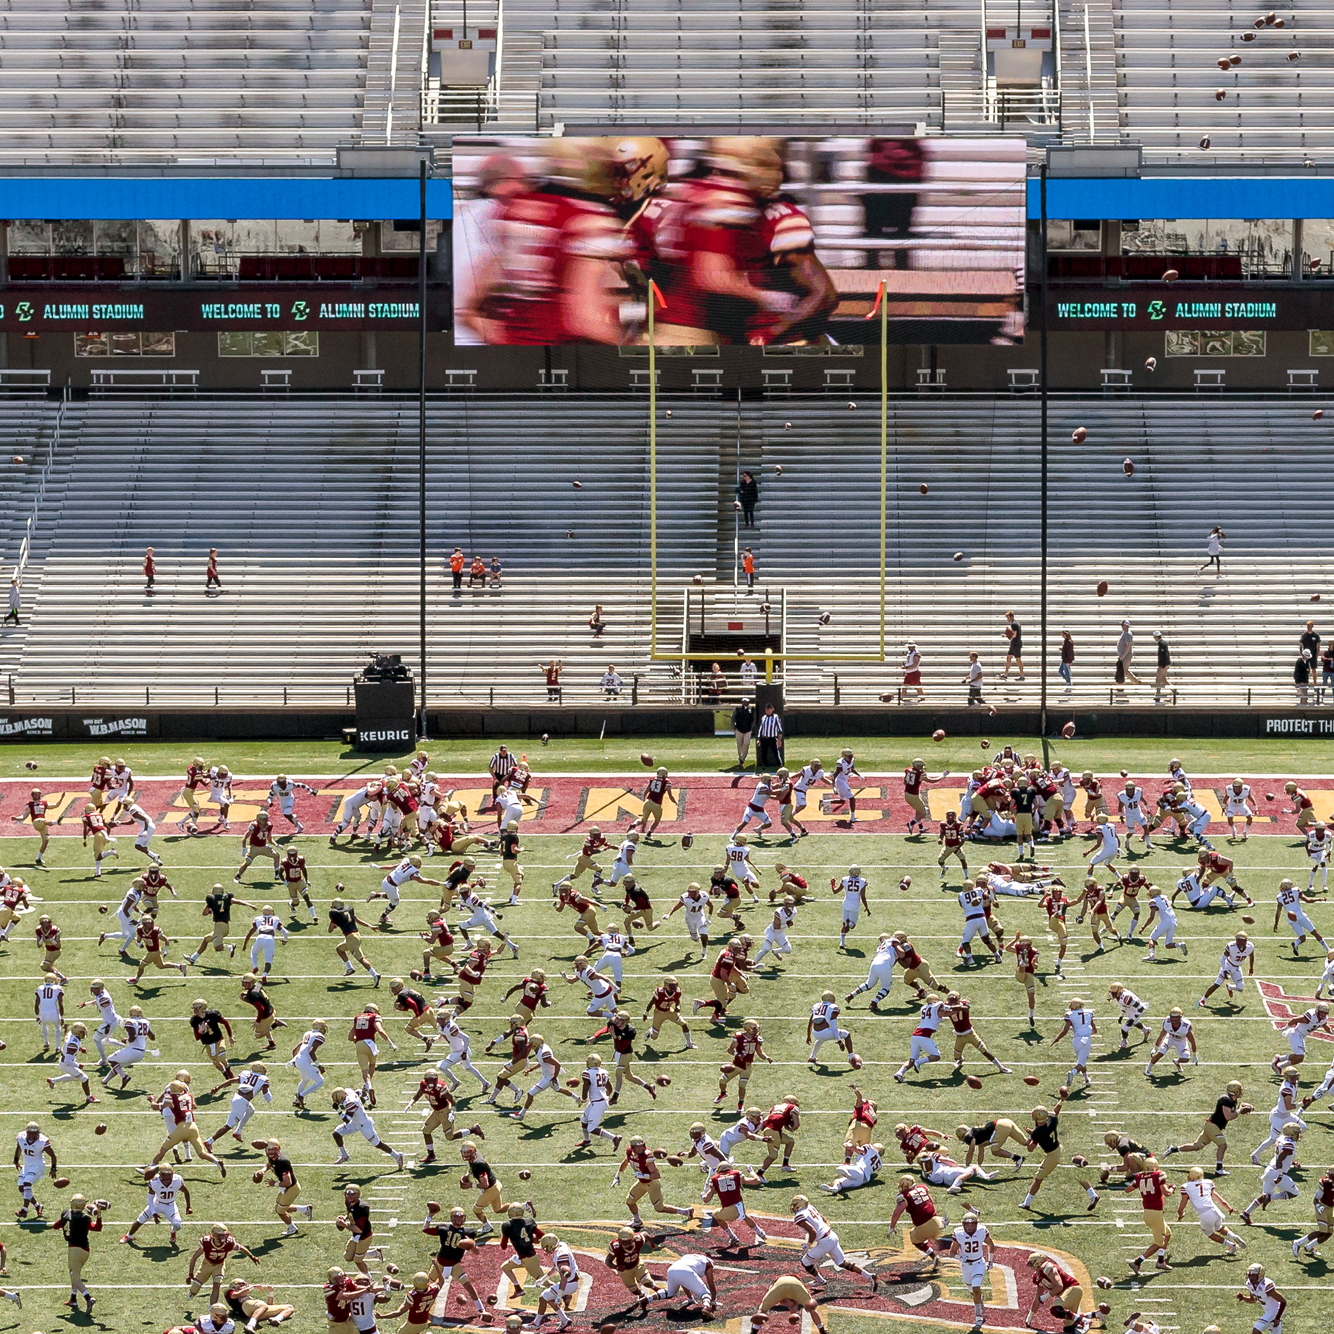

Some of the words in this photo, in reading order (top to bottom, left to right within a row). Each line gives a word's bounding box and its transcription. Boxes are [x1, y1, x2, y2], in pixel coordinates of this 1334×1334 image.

[43, 304, 89, 319] ALUMNI
[92, 304, 144, 319] STADIUM
[201, 303, 262, 318] WELCOME
[265, 303, 280, 318] TO
[319, 303, 365, 318] ALUMNI
[368, 303, 420, 318] STADIUM
[1057, 303, 1118, 318] WELCOME
[1122, 303, 1136, 318] TO
[1175, 303, 1221, 318] ALUMNI
[1225, 303, 1276, 318] STADIUM
[1267, 719, 1314, 733] PROTECT
[360, 730, 410, 742] KEURIG
[1137, 1179, 1155, 1196] 44
[965, 1241, 979, 1253] 32
